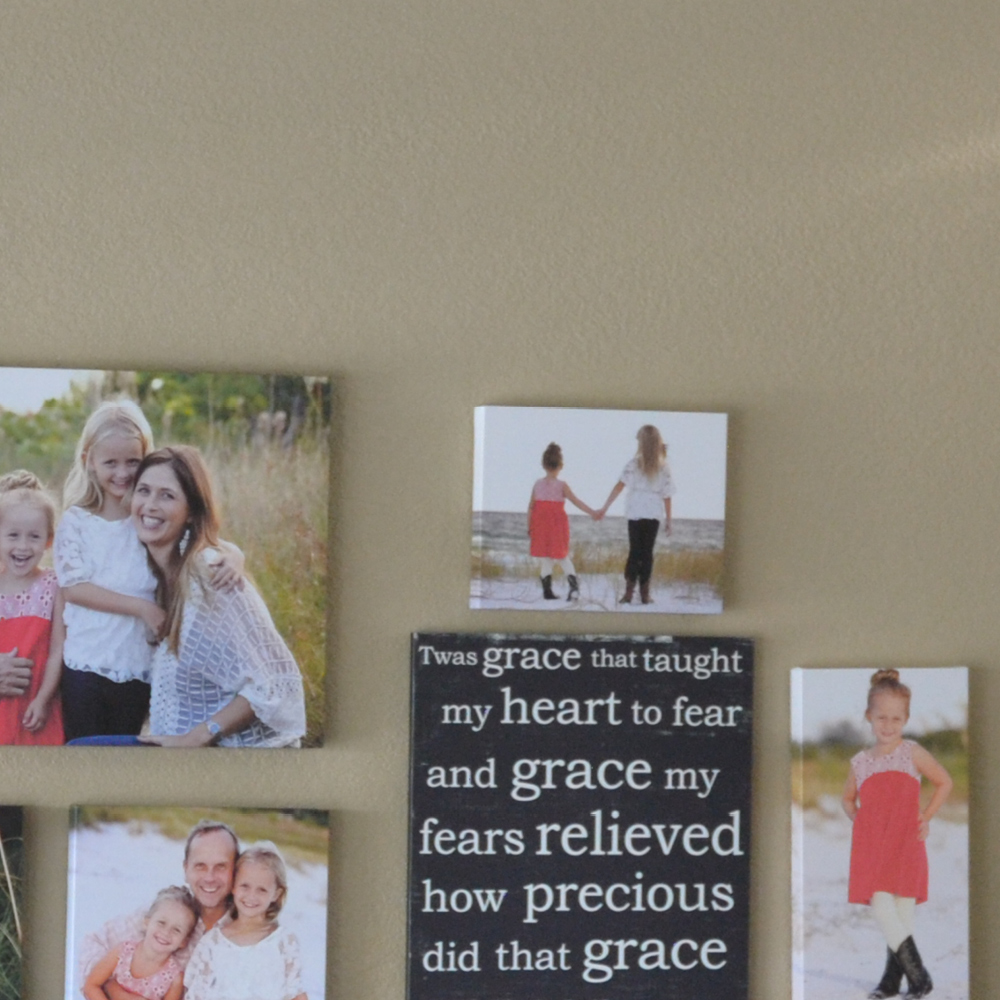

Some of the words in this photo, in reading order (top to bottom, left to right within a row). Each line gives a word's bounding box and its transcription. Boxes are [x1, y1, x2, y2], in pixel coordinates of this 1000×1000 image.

[418, 645, 479, 666] Twas
[481, 647, 582, 678] grace
[590, 648, 637, 669] that
[642, 647, 743, 680] taught
[441, 704, 493, 732] my
[500, 686, 623, 725] heart
[630, 700, 663, 726] to
[672, 696, 743, 727] fear
[426, 758, 498, 789] and
[510, 758, 652, 802] grace
[664, 768, 721, 799] my
[418, 817, 526, 856] fears
[535, 809, 745, 857] relieved
[421, 879, 508, 913] how
[522, 871, 735, 924] precious
[422, 941, 482, 972] did
[494, 940, 572, 971] that
[581, 938, 728, 984] grace
